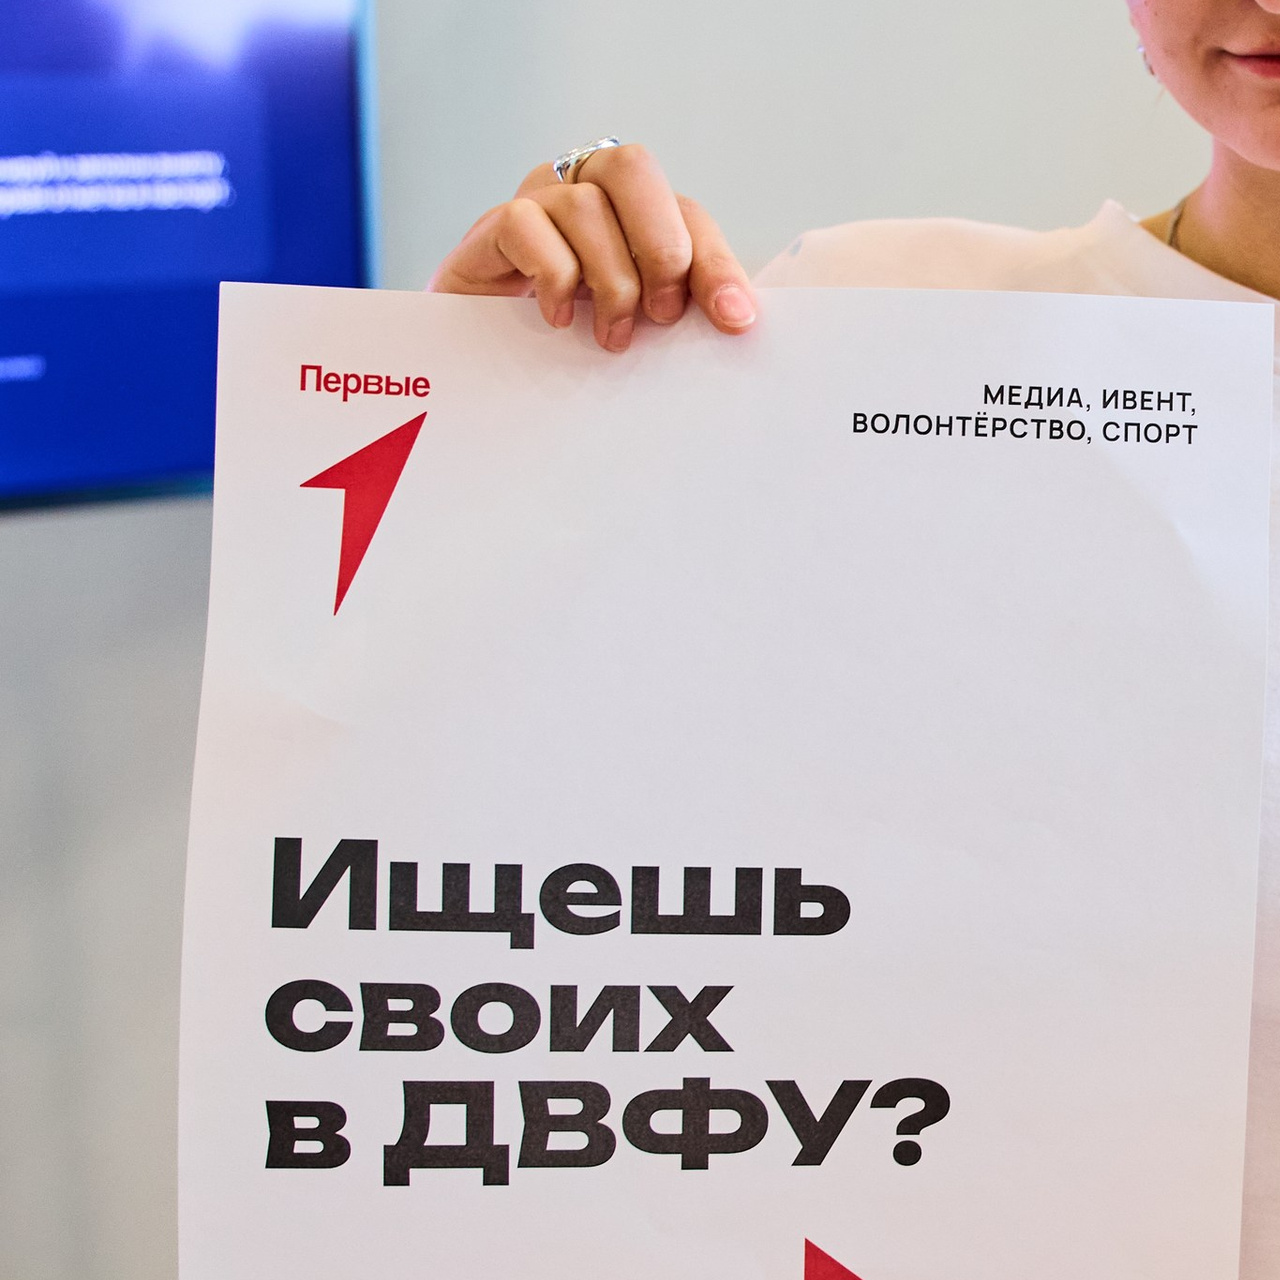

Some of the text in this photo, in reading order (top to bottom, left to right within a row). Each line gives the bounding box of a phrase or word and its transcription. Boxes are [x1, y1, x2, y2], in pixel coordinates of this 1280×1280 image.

[299, 363, 431, 403] Первые
[982, 383, 1197, 418] МЕДИА, ИВЕНТ,
[851, 410, 1200, 446] ВОЛОНТЁРСТВО, СПОРТ
[270, 836, 852, 950] Ищешь
[264, 978, 735, 1055] своих
[264, 1076, 952, 1187] в ДВФУ?
